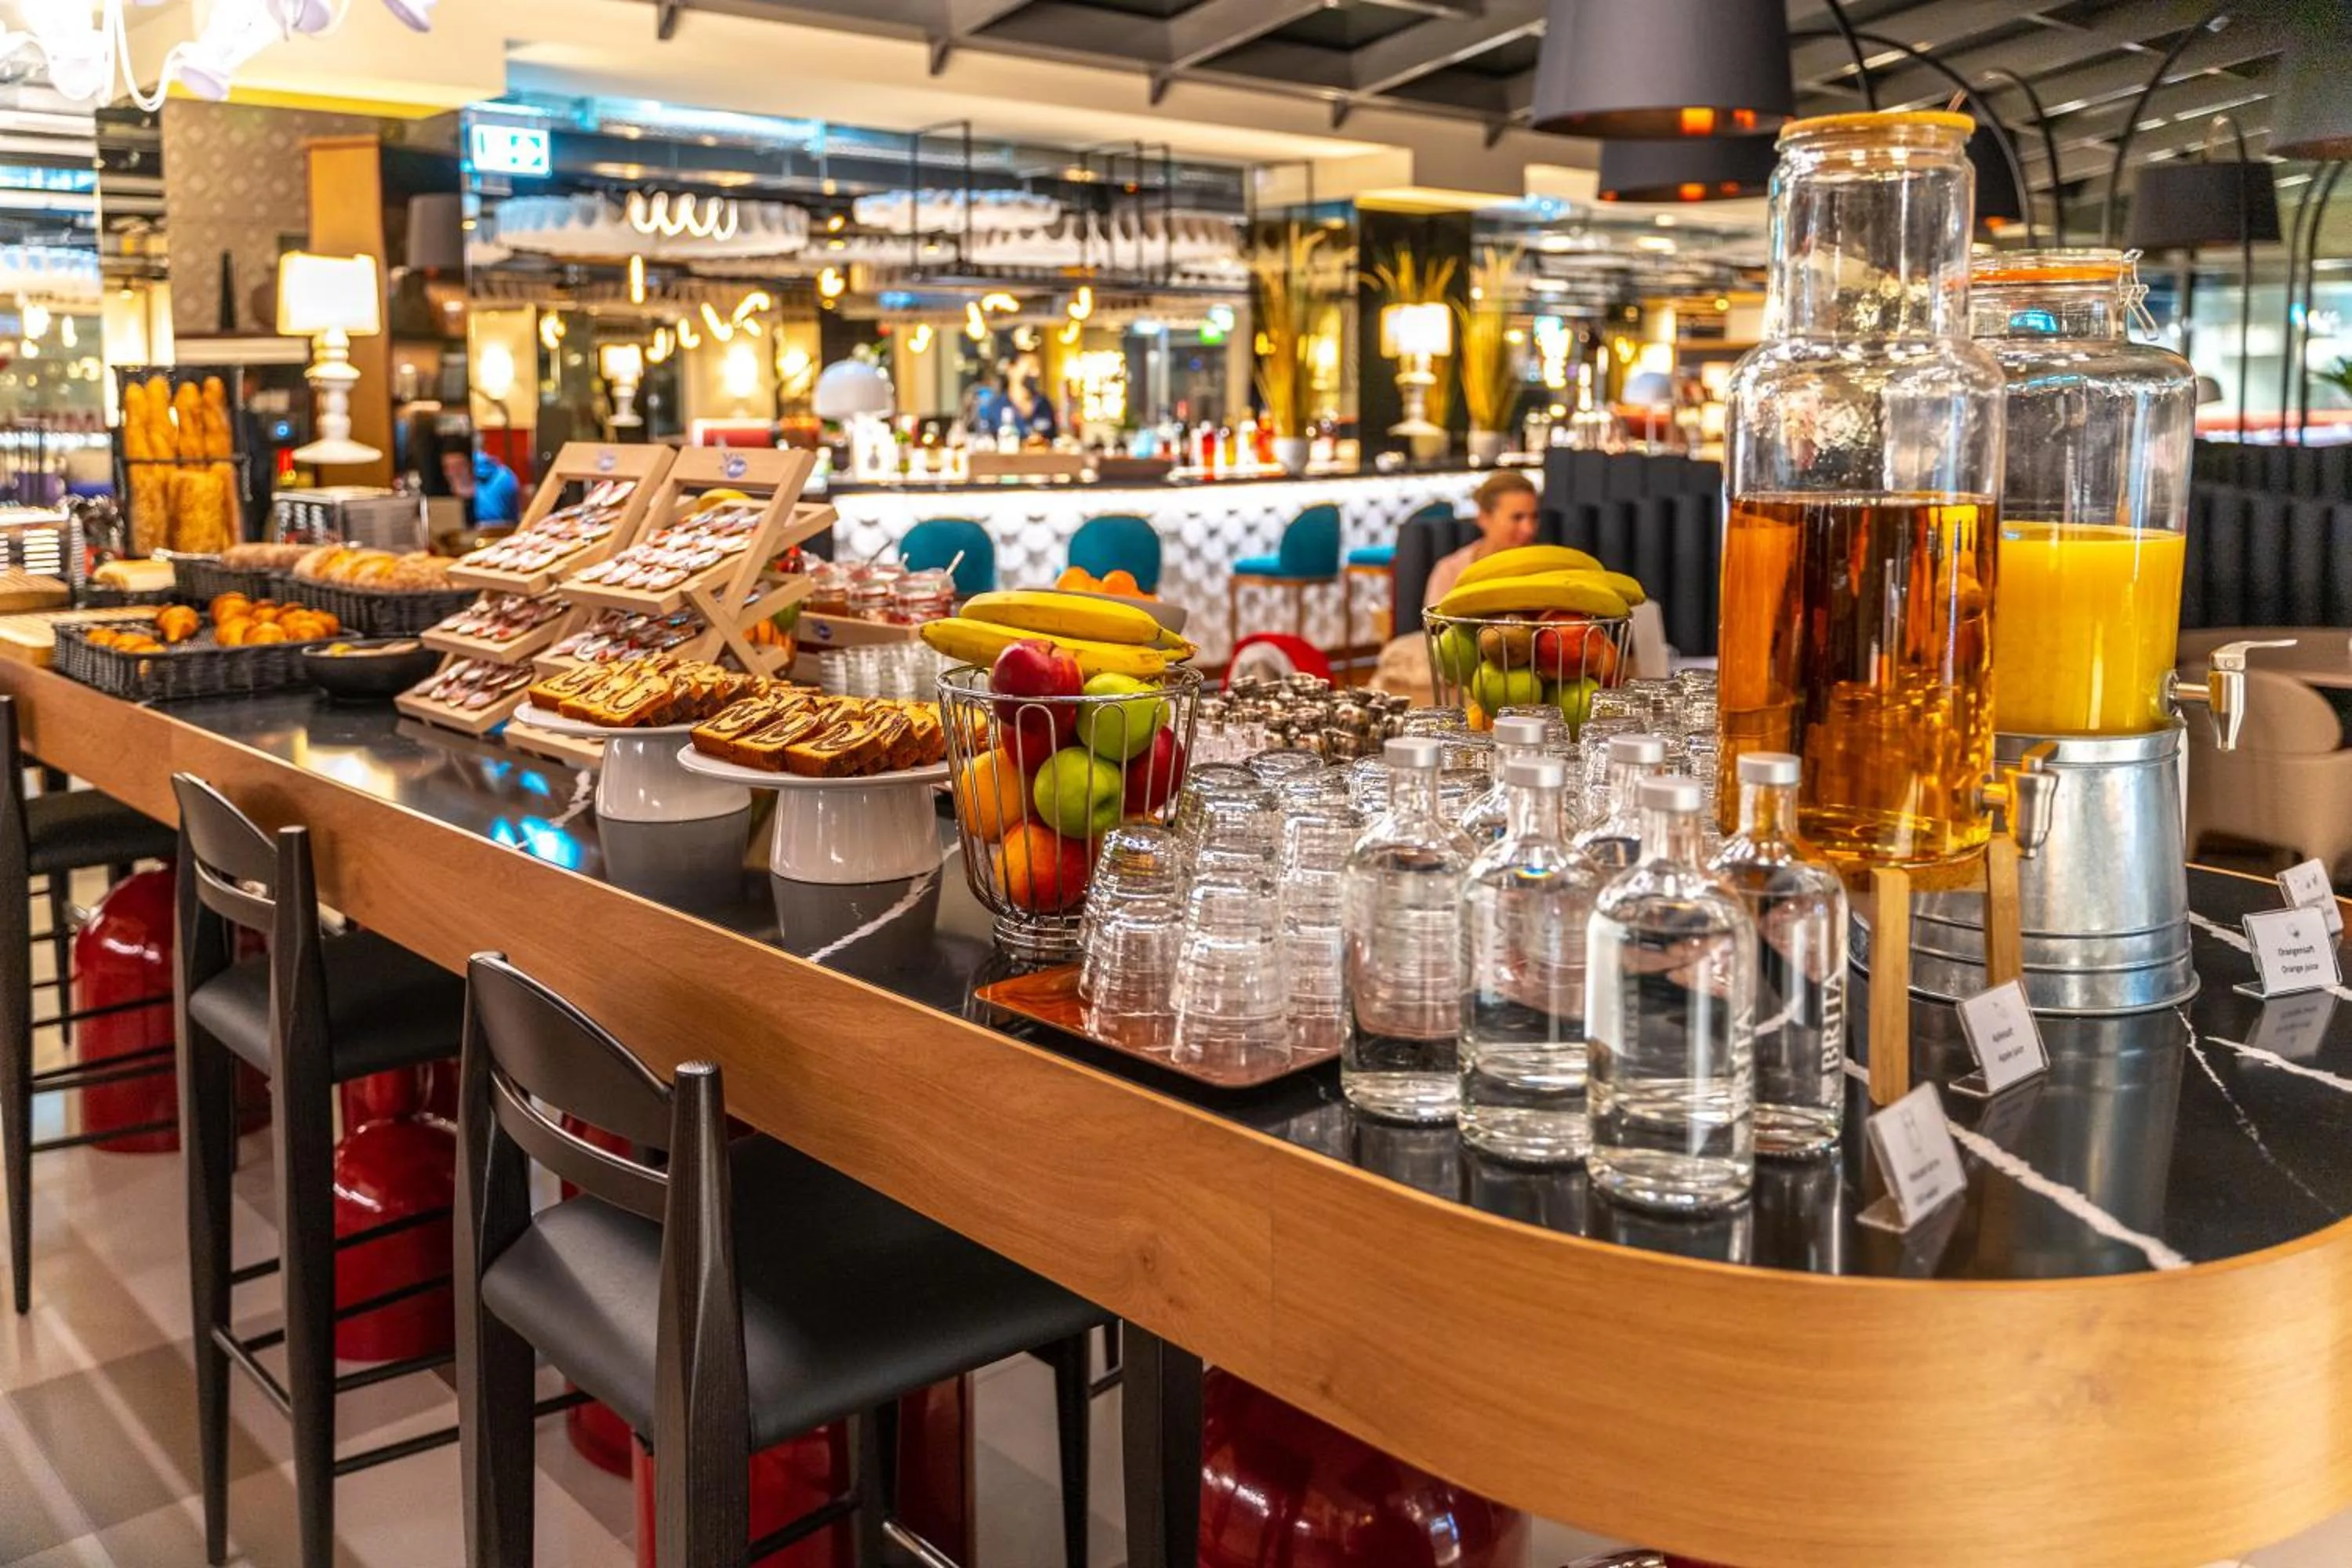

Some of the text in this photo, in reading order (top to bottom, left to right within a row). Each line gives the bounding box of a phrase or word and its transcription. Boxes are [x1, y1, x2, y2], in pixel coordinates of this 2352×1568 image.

[2281, 964, 2318, 974] Orange juice
[1822, 968, 1842, 1073] BRITA
